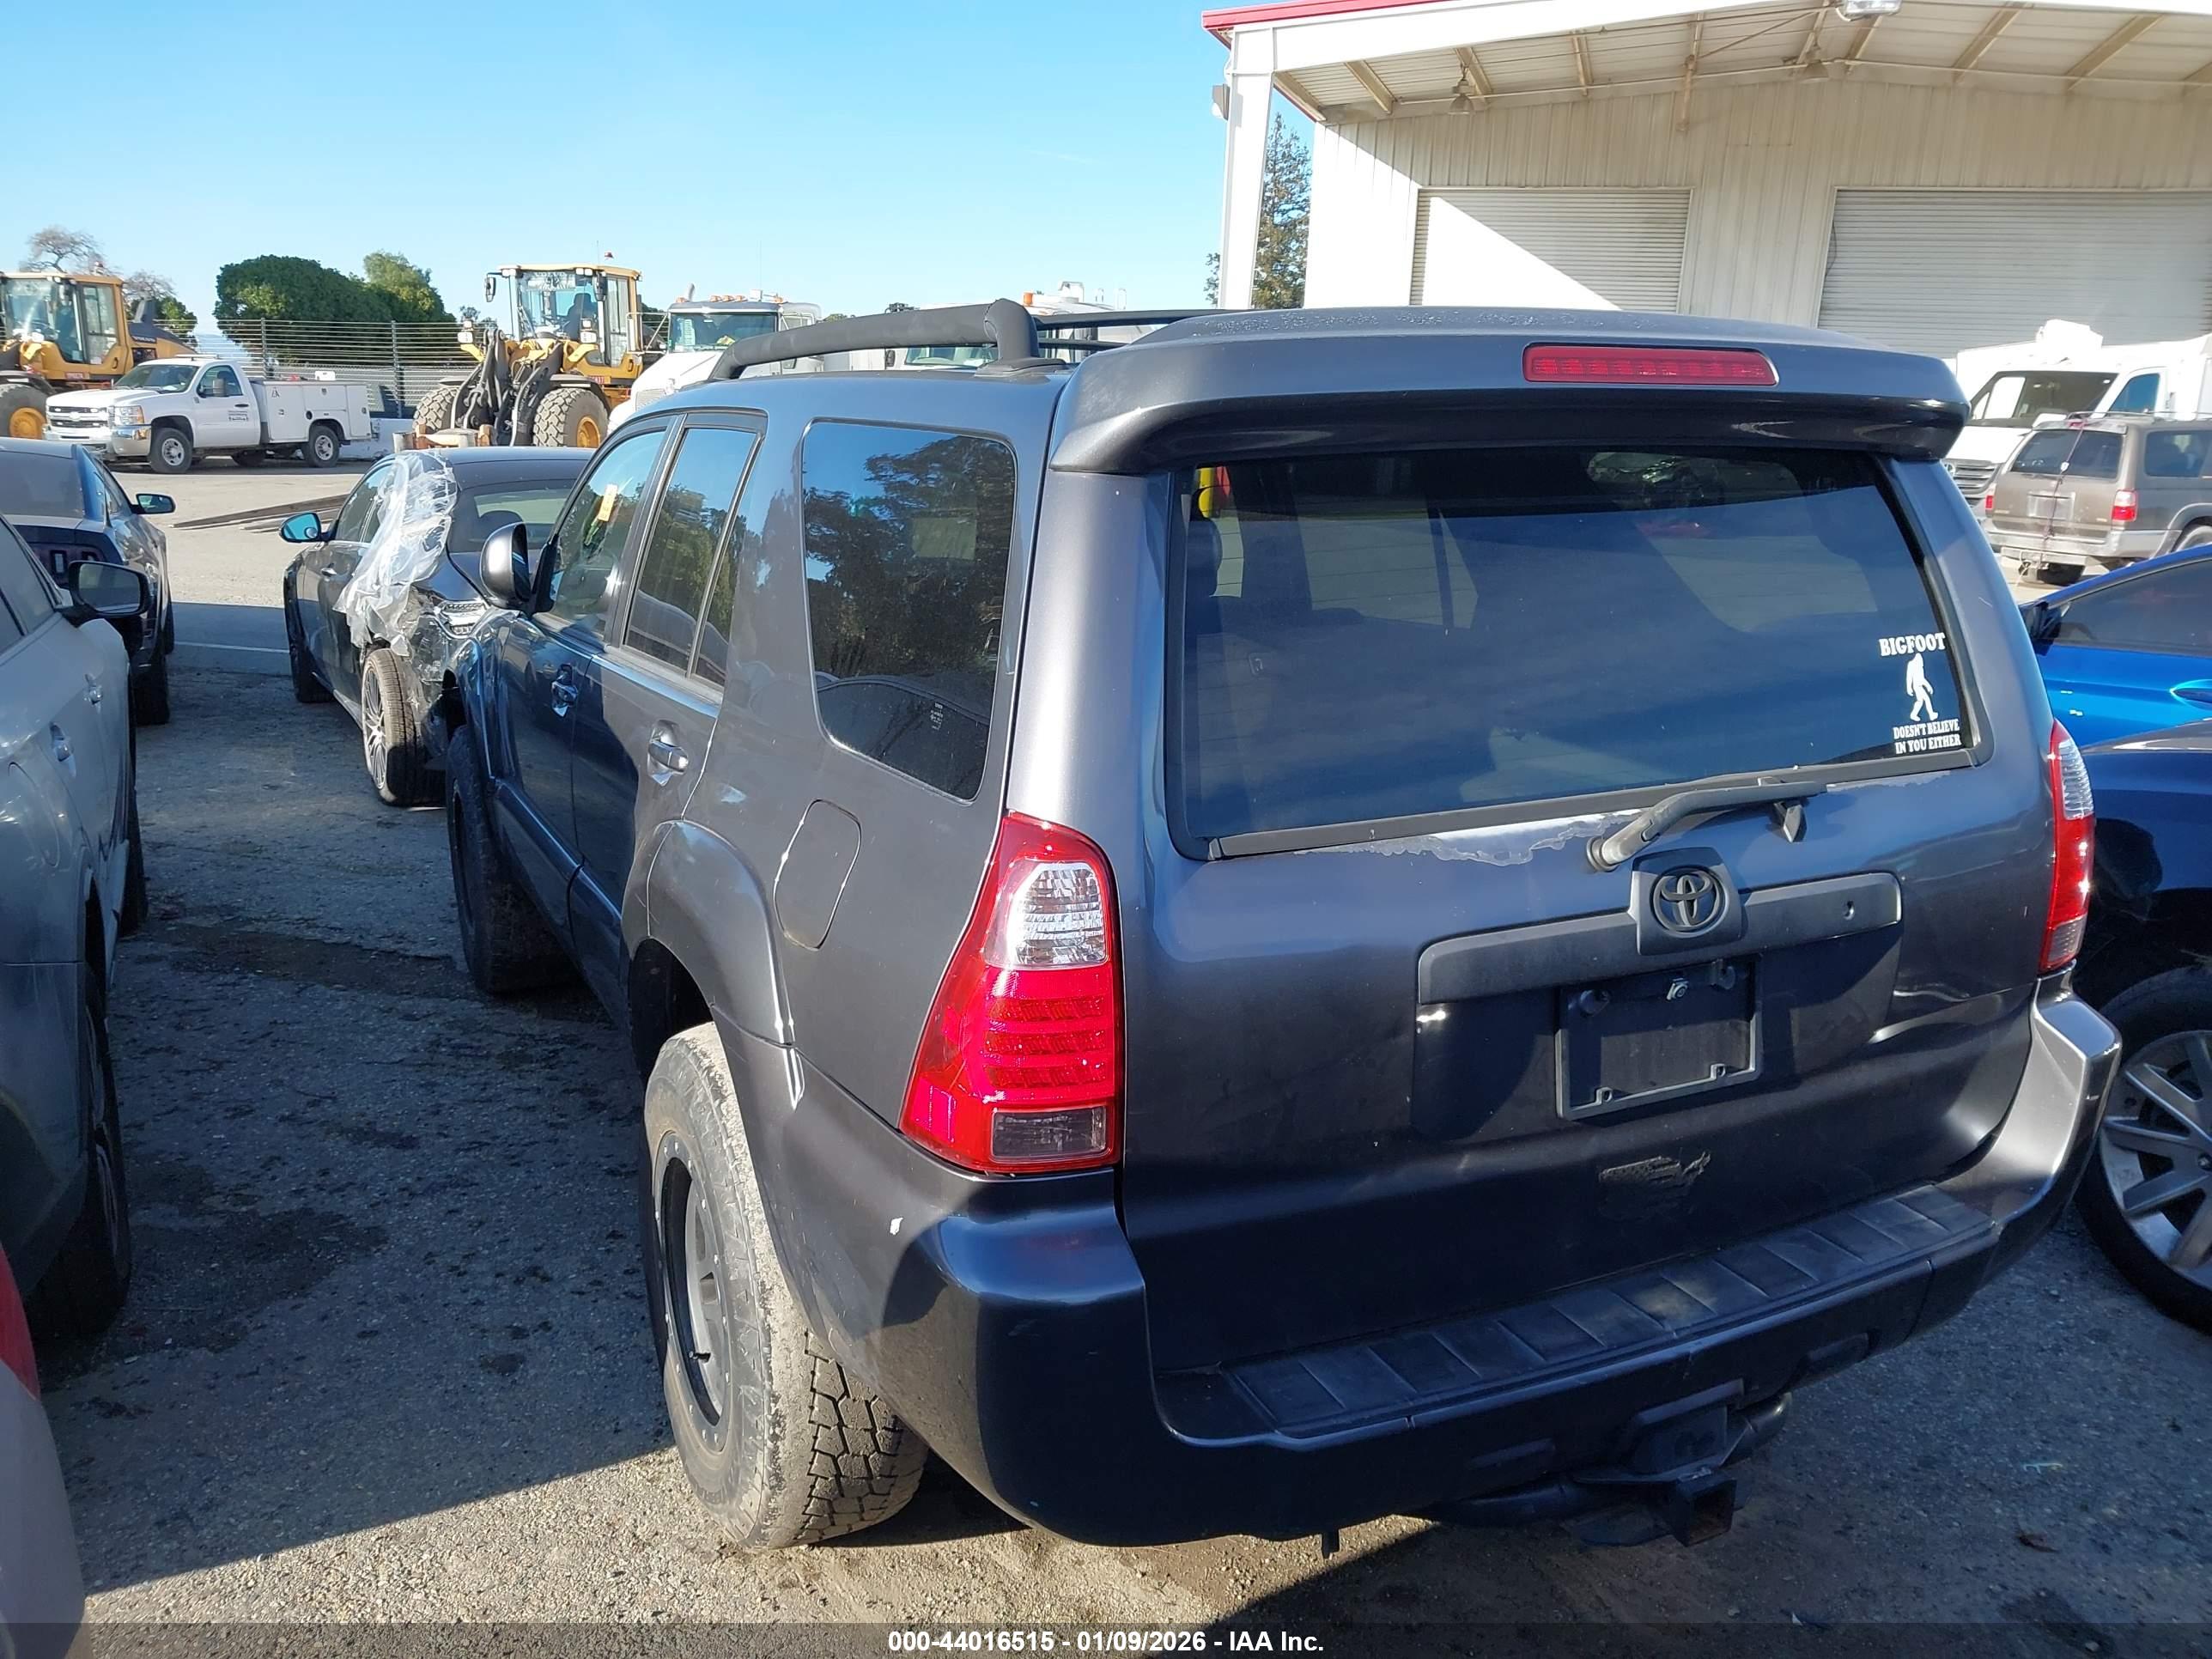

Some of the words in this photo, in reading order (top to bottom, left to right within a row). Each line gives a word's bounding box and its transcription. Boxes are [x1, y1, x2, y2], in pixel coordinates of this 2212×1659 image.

[1878, 632, 1946, 657] BIGFOOT
[1893, 723, 1927, 739] DOESN'T
[1927, 718, 1960, 735] BELIEVE
[1894, 740, 1907, 755] IN
[1907, 738, 1927, 753] YOU
[1928, 733, 1962, 750] EITHER
